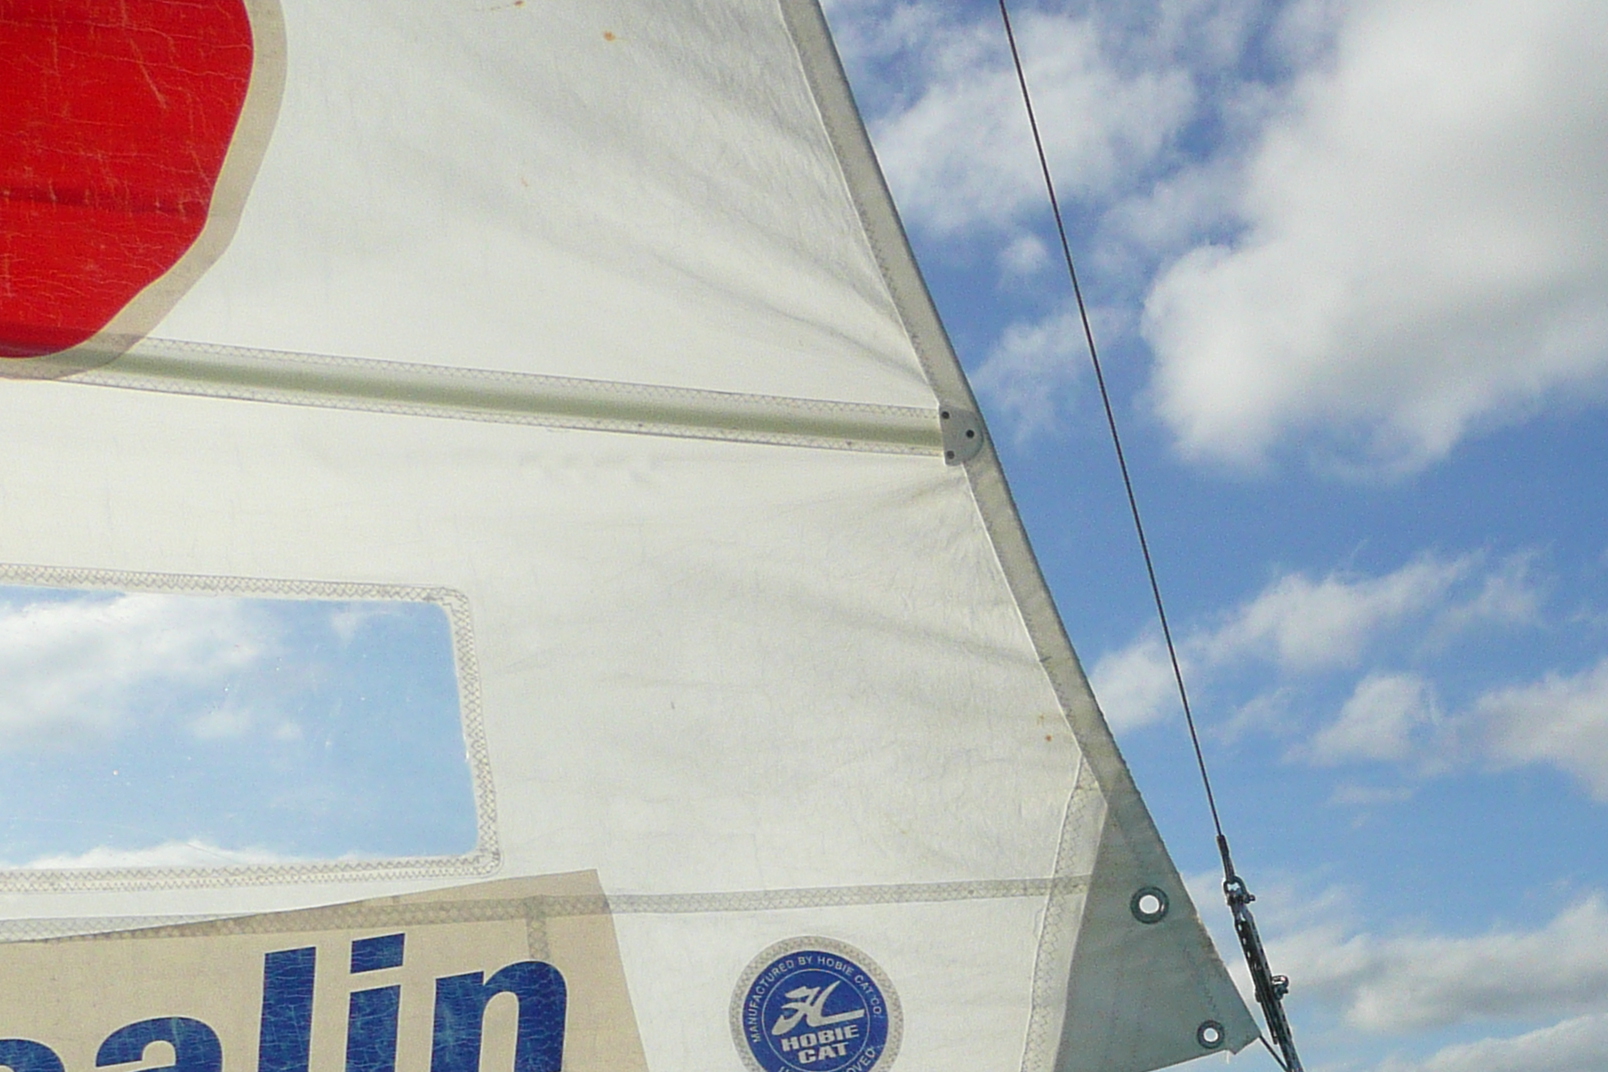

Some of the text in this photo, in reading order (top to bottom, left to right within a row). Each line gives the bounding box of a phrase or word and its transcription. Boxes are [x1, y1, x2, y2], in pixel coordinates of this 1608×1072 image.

[748, 959, 795, 1043] MANUFACTURED
[798, 956, 813, 966] BY
[818, 956, 855, 976] HOBIE
[854, 974, 874, 995] CAT
[781, 1024, 860, 1052] HOBIE
[798, 1042, 849, 1064] CAT
